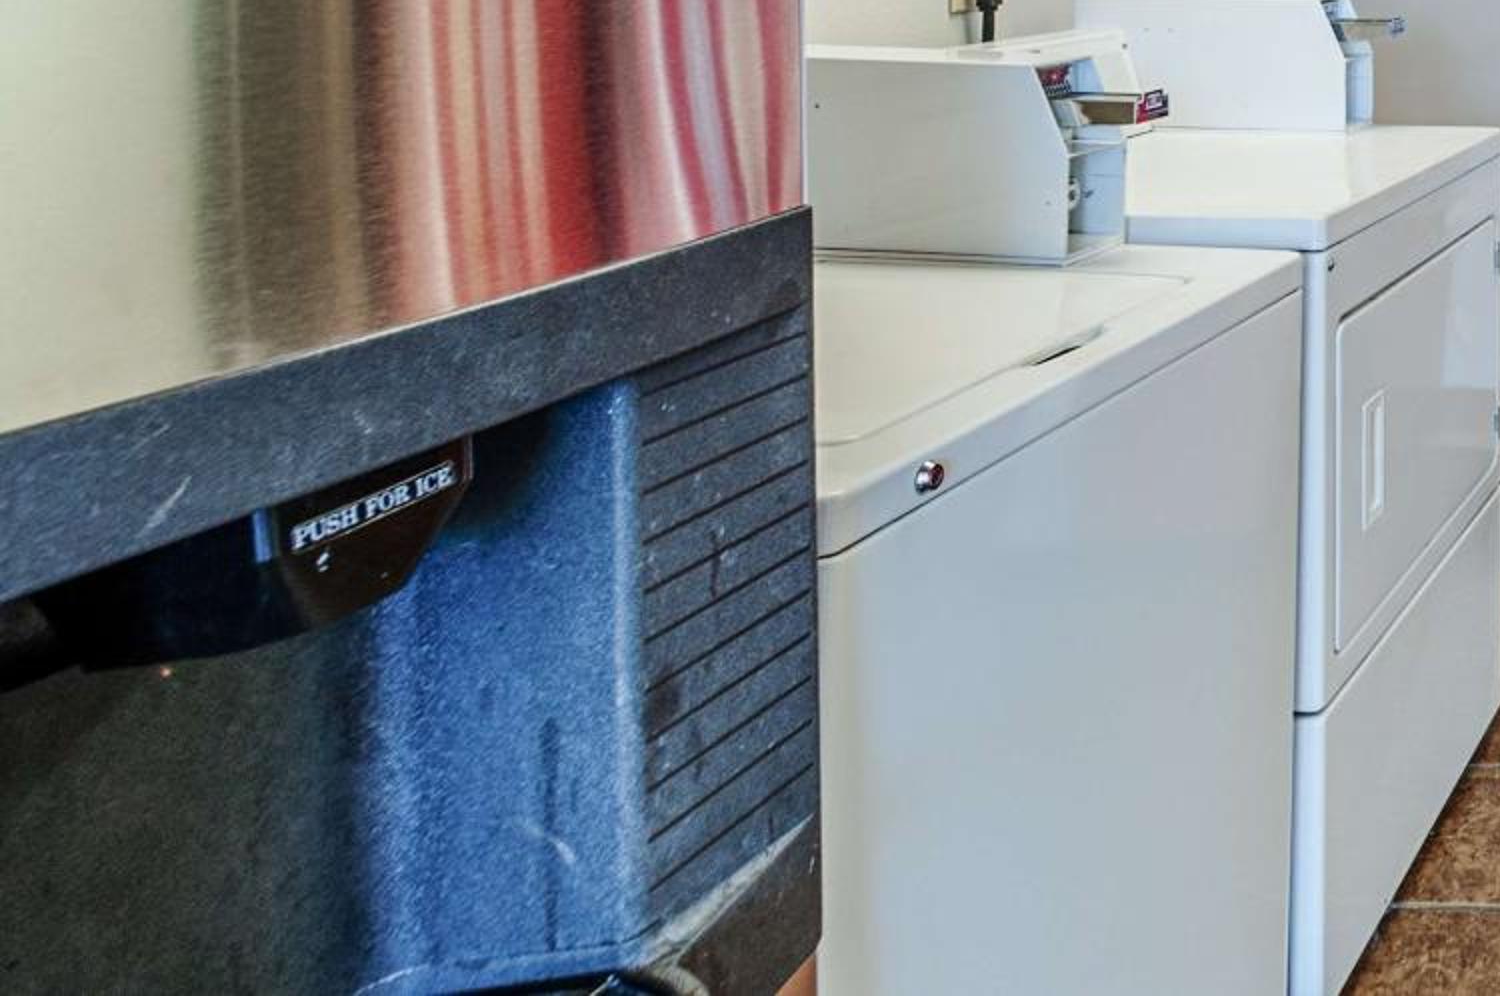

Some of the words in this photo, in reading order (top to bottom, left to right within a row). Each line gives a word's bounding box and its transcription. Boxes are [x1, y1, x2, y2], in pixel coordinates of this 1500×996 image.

[292, 506, 358, 550] PUSH
[365, 483, 411, 518] FOR
[414, 467, 454, 497] ICE
